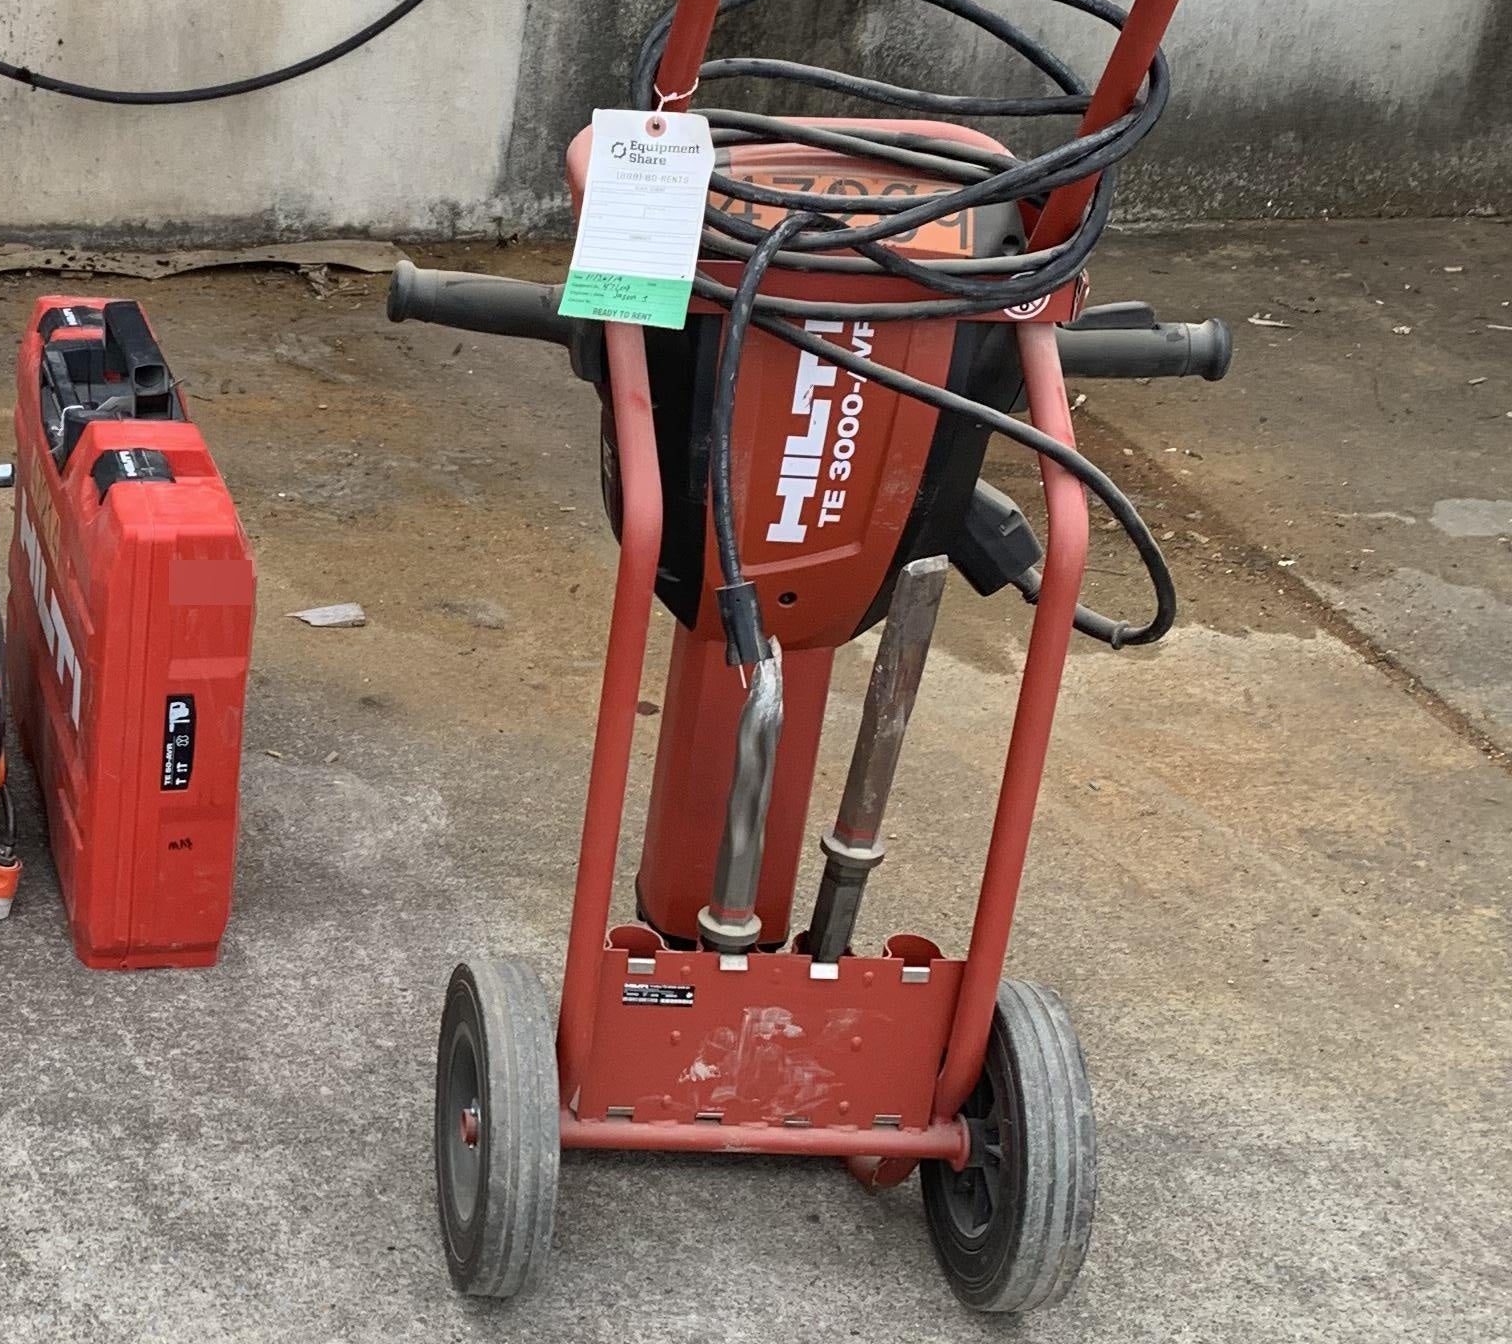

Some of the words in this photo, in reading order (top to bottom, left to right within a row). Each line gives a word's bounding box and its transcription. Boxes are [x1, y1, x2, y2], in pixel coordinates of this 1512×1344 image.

[628, 152, 667, 166] Share
[629, 140, 701, 155] Equipment
[592, 307, 618, 318] READY
[620, 310, 631, 319] TO
[766, 319, 845, 544] HILTI
[817, 489, 847, 529] TE
[20, 485, 82, 732] HILTI
